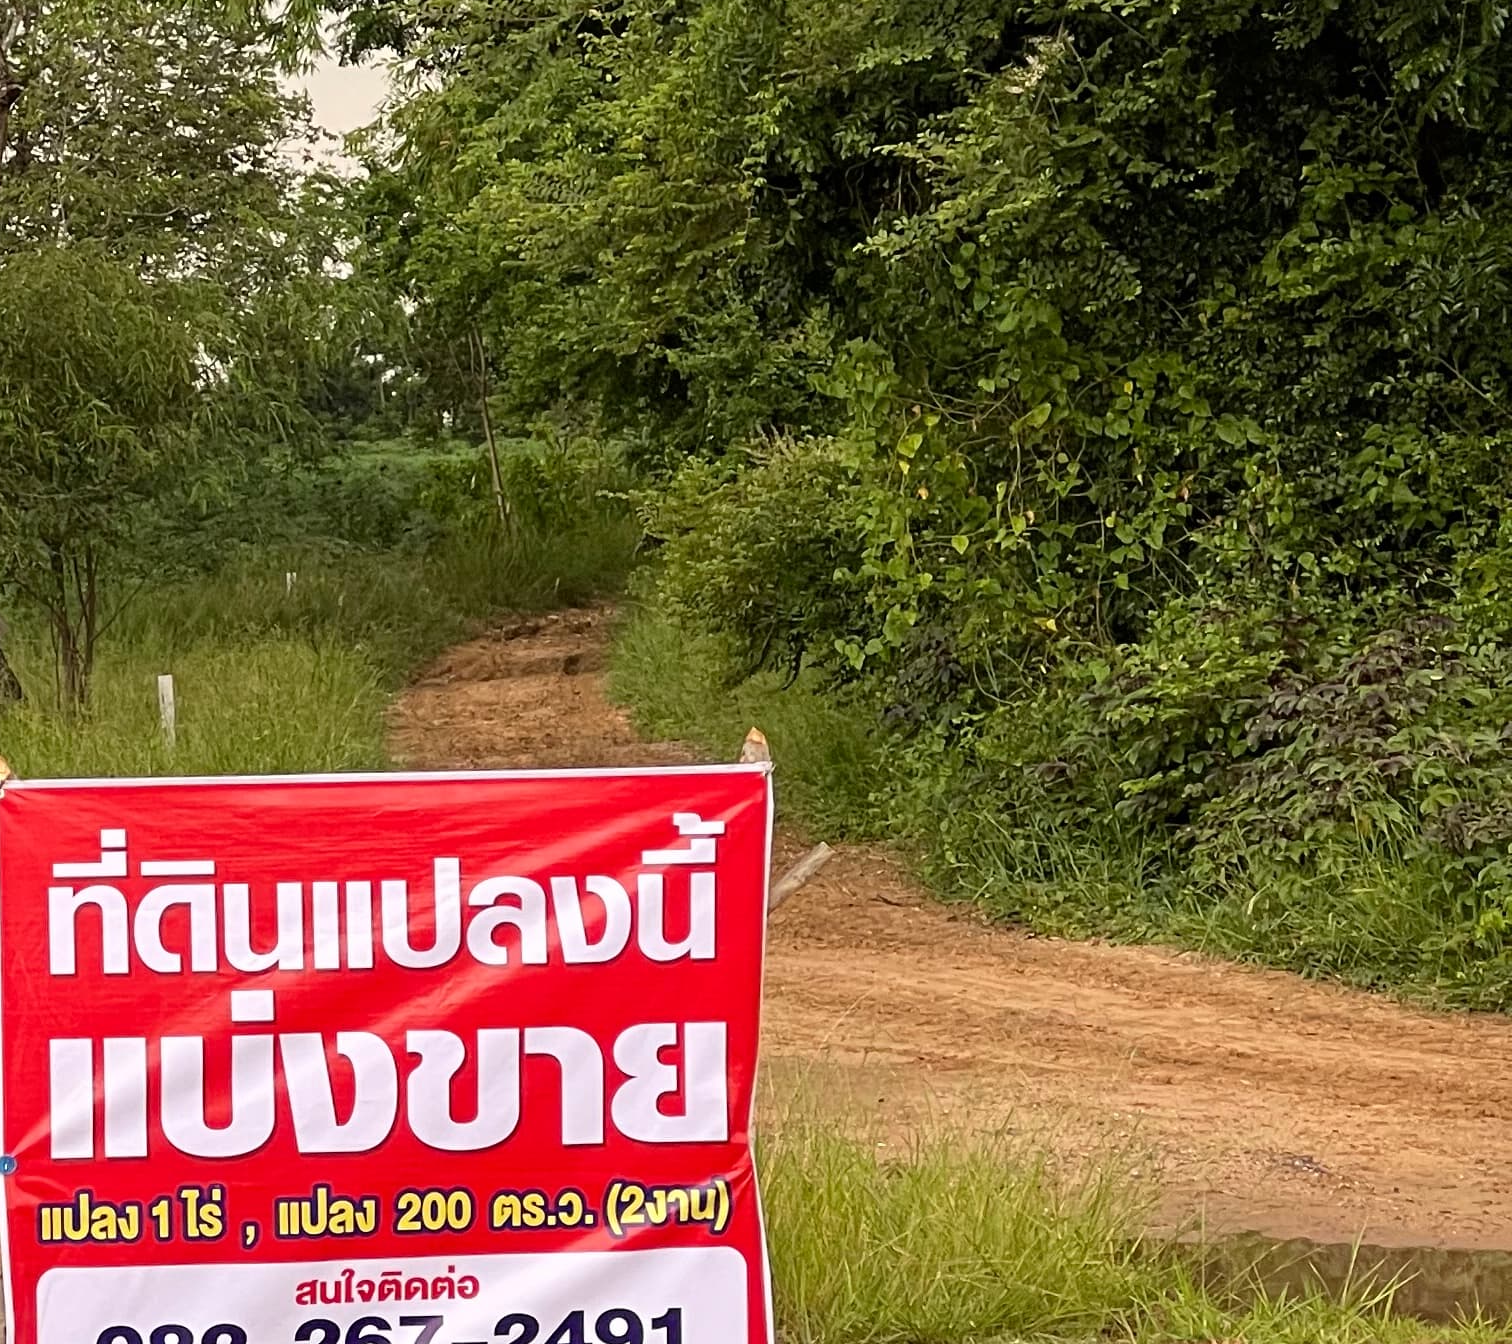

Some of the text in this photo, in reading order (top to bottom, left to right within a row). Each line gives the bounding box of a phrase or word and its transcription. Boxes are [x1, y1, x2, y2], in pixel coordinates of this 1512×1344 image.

[48, 813, 726, 975] ที่ดินแปลงนี้
[50, 990, 728, 1158] แบ่งขาย
[41, 1193, 139, 1240] แปลง
[152, 1200, 169, 1238] 1
[181, 1188, 223, 1237] ไร่
[279, 1187, 376, 1235] แปลง
[397, 1191, 472, 1231] 200
[493, 1192, 594, 1227] ตร.ว.
[606, 1181, 730, 1235] (2งาน)
[295, 1265, 480, 1306] สนใจติดต่อ
